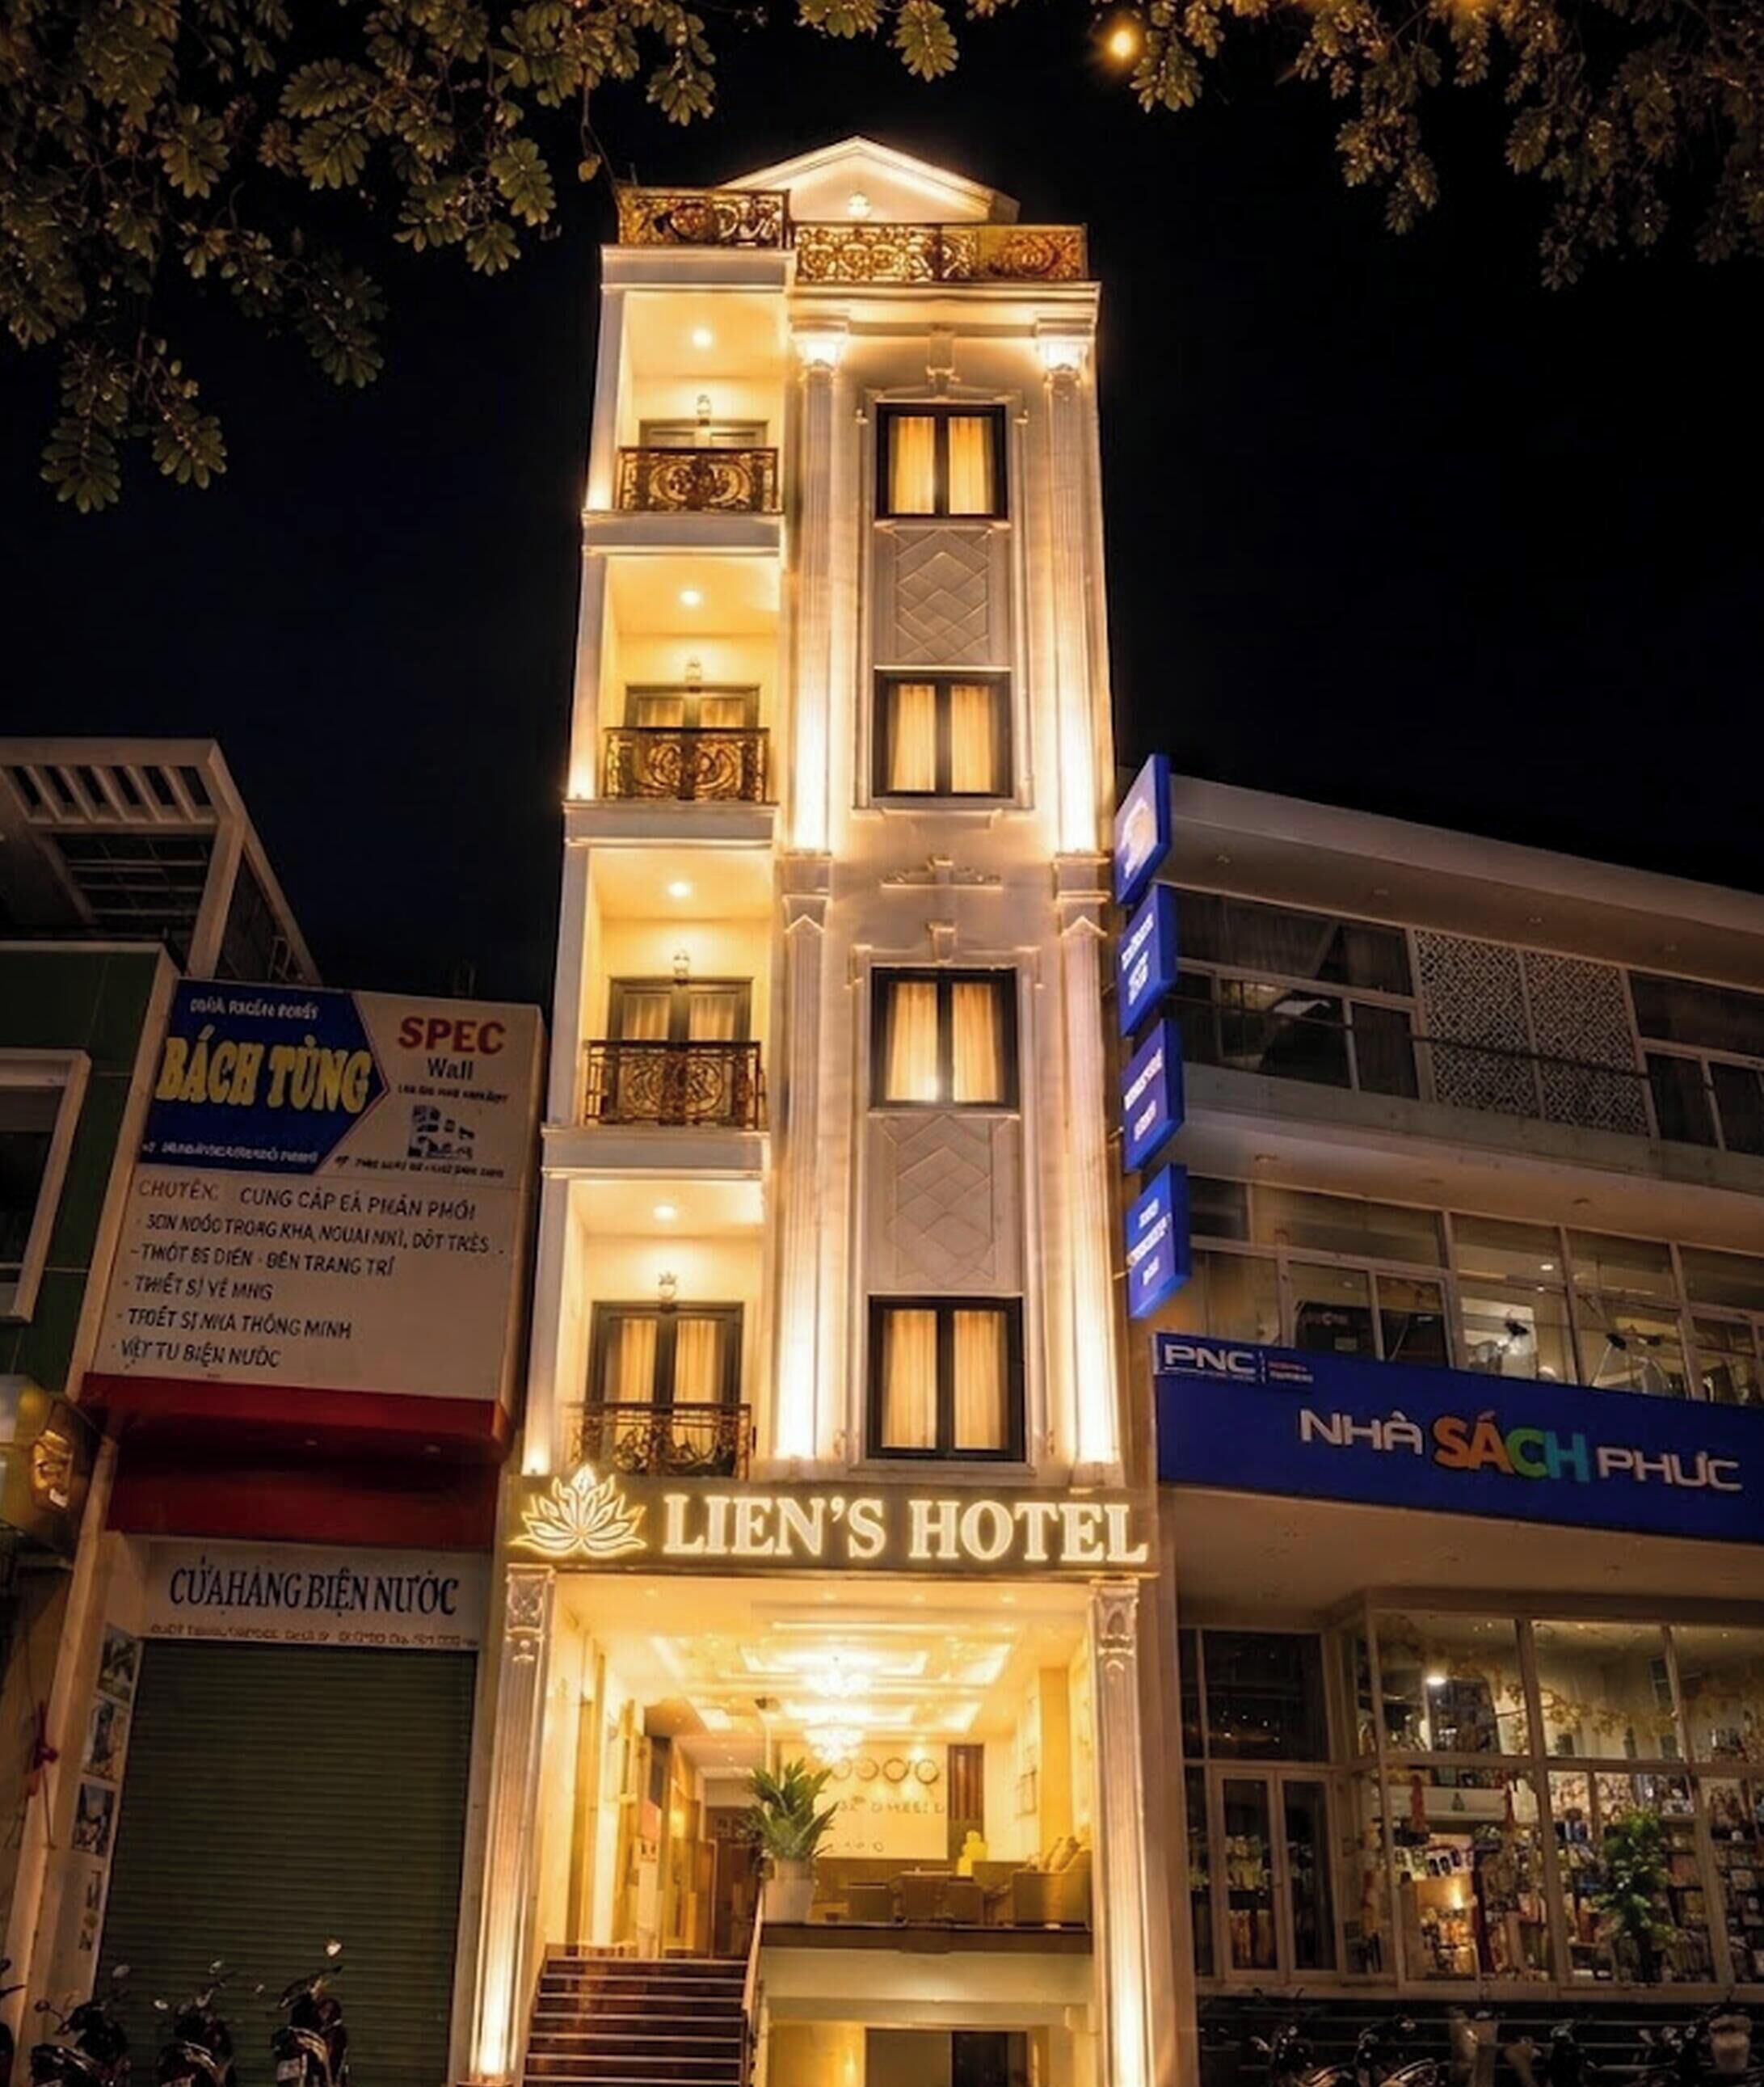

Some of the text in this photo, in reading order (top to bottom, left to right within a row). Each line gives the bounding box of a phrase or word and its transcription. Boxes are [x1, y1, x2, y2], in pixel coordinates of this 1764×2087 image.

[398, 1016, 506, 1054] SPEC
[155, 1023, 265, 1106] BÁCH
[428, 1058, 473, 1080] Wall
[240, 1187, 293, 1208] CUNG
[304, 1254, 360, 1275] TRANG
[304, 1319, 352, 1339] MINH
[1164, 1343, 1257, 1374] PNC
[1433, 1410, 1592, 1484] SÁCH
[907, 1499, 1148, 1563] HOTEL
